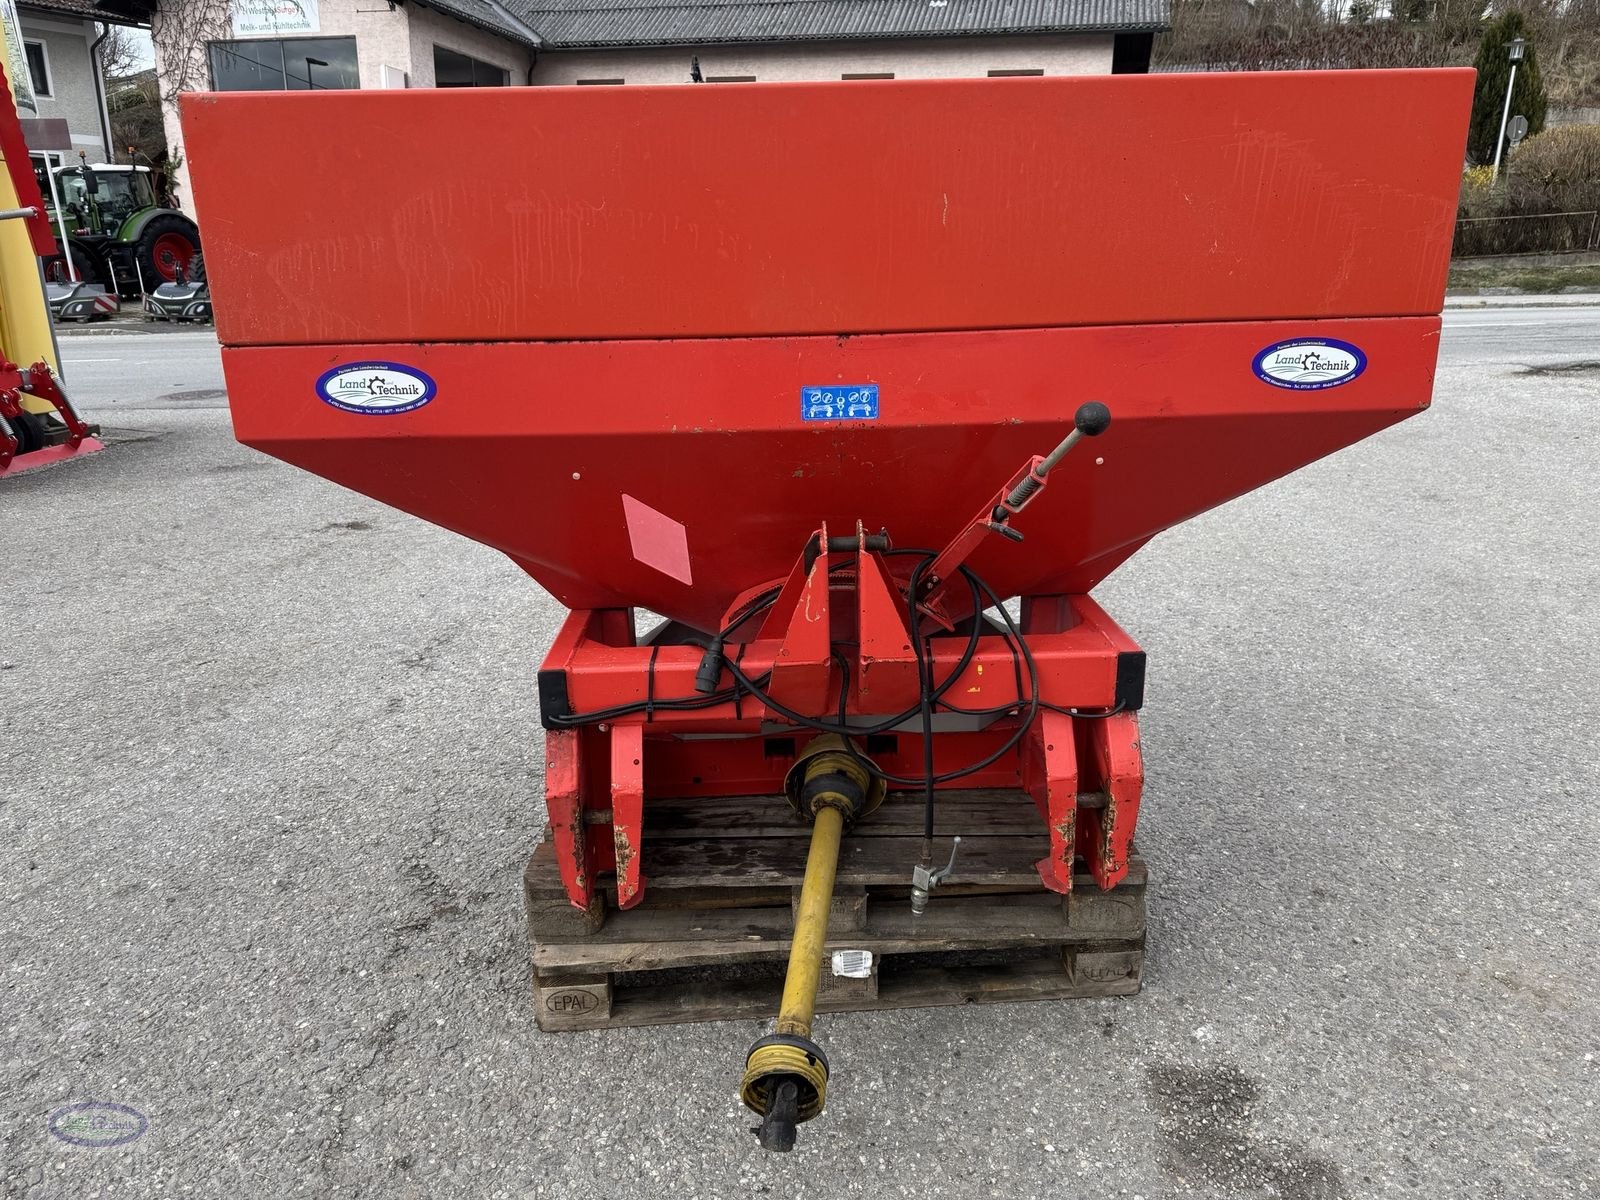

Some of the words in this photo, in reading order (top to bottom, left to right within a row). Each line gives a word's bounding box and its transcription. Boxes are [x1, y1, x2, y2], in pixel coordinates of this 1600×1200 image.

[240, 23, 258, 31] Melk-
[1275, 353, 1302, 364] Land
[1310, 360, 1350, 370] Technik
[339, 378, 366, 389] Land
[377, 384, 419, 395] Technik
[554, 995, 592, 1011] EPAL
